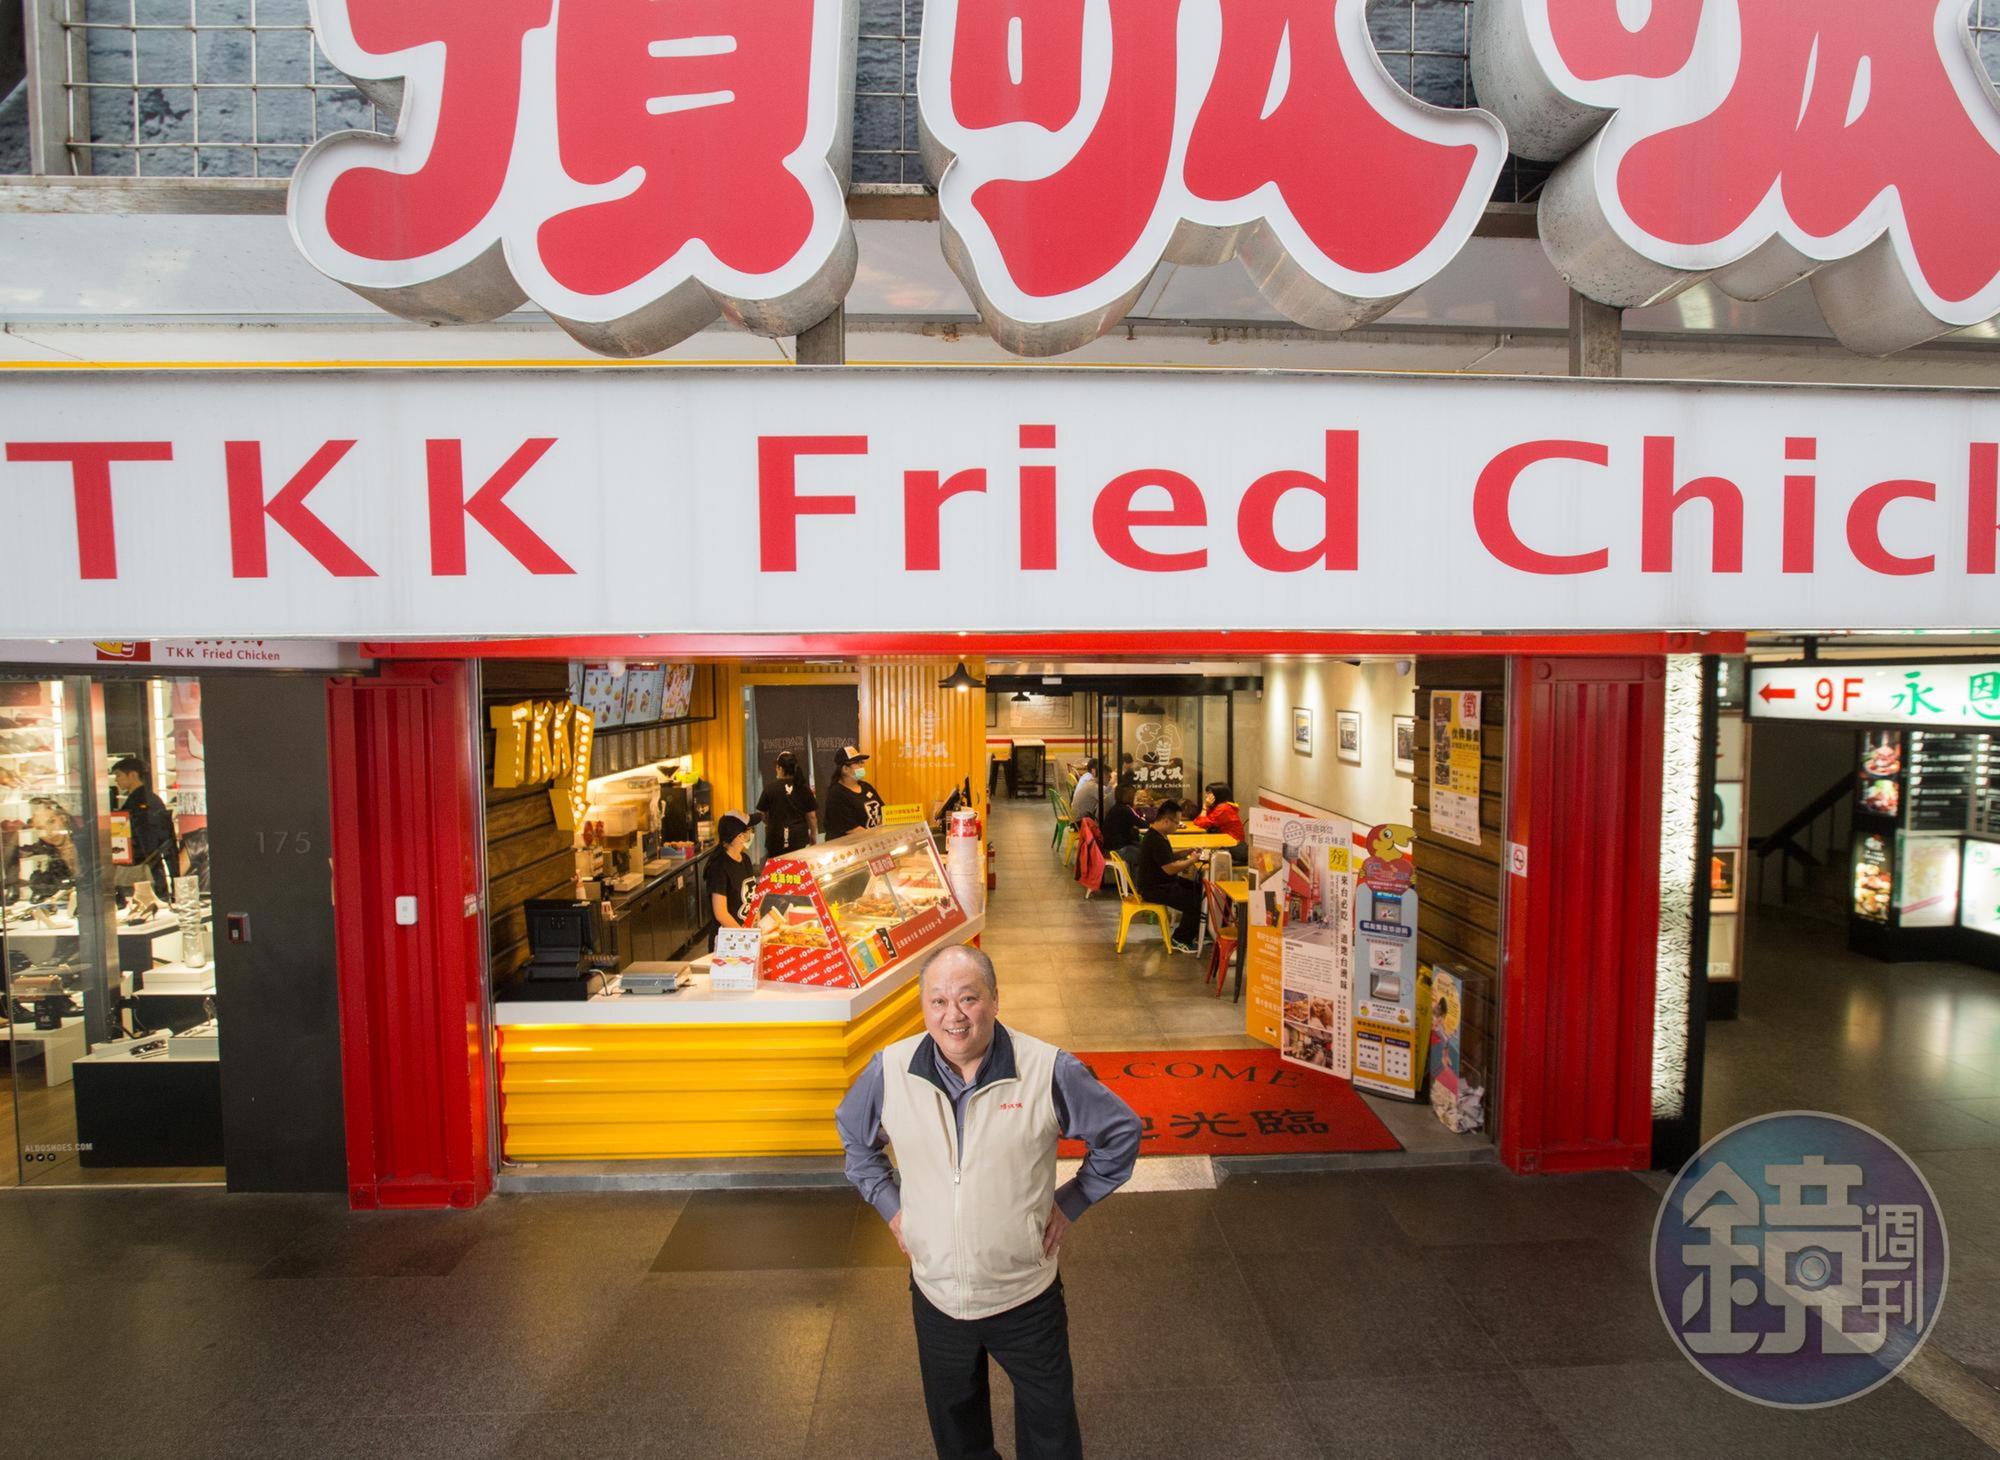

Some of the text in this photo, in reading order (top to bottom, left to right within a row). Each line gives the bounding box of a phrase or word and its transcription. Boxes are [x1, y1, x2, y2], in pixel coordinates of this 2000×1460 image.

[5, 437, 579, 580] TKK
[758, 424, 1360, 573] Fried
[165, 646, 280, 661] TKK Fried Chicken
[1815, 677, 1864, 712] 9F
[256, 831, 312, 854] 175
[1089, 1062, 1306, 1088] LCOME
[25, 1142, 94, 1153] ALDOSHOES.COM
